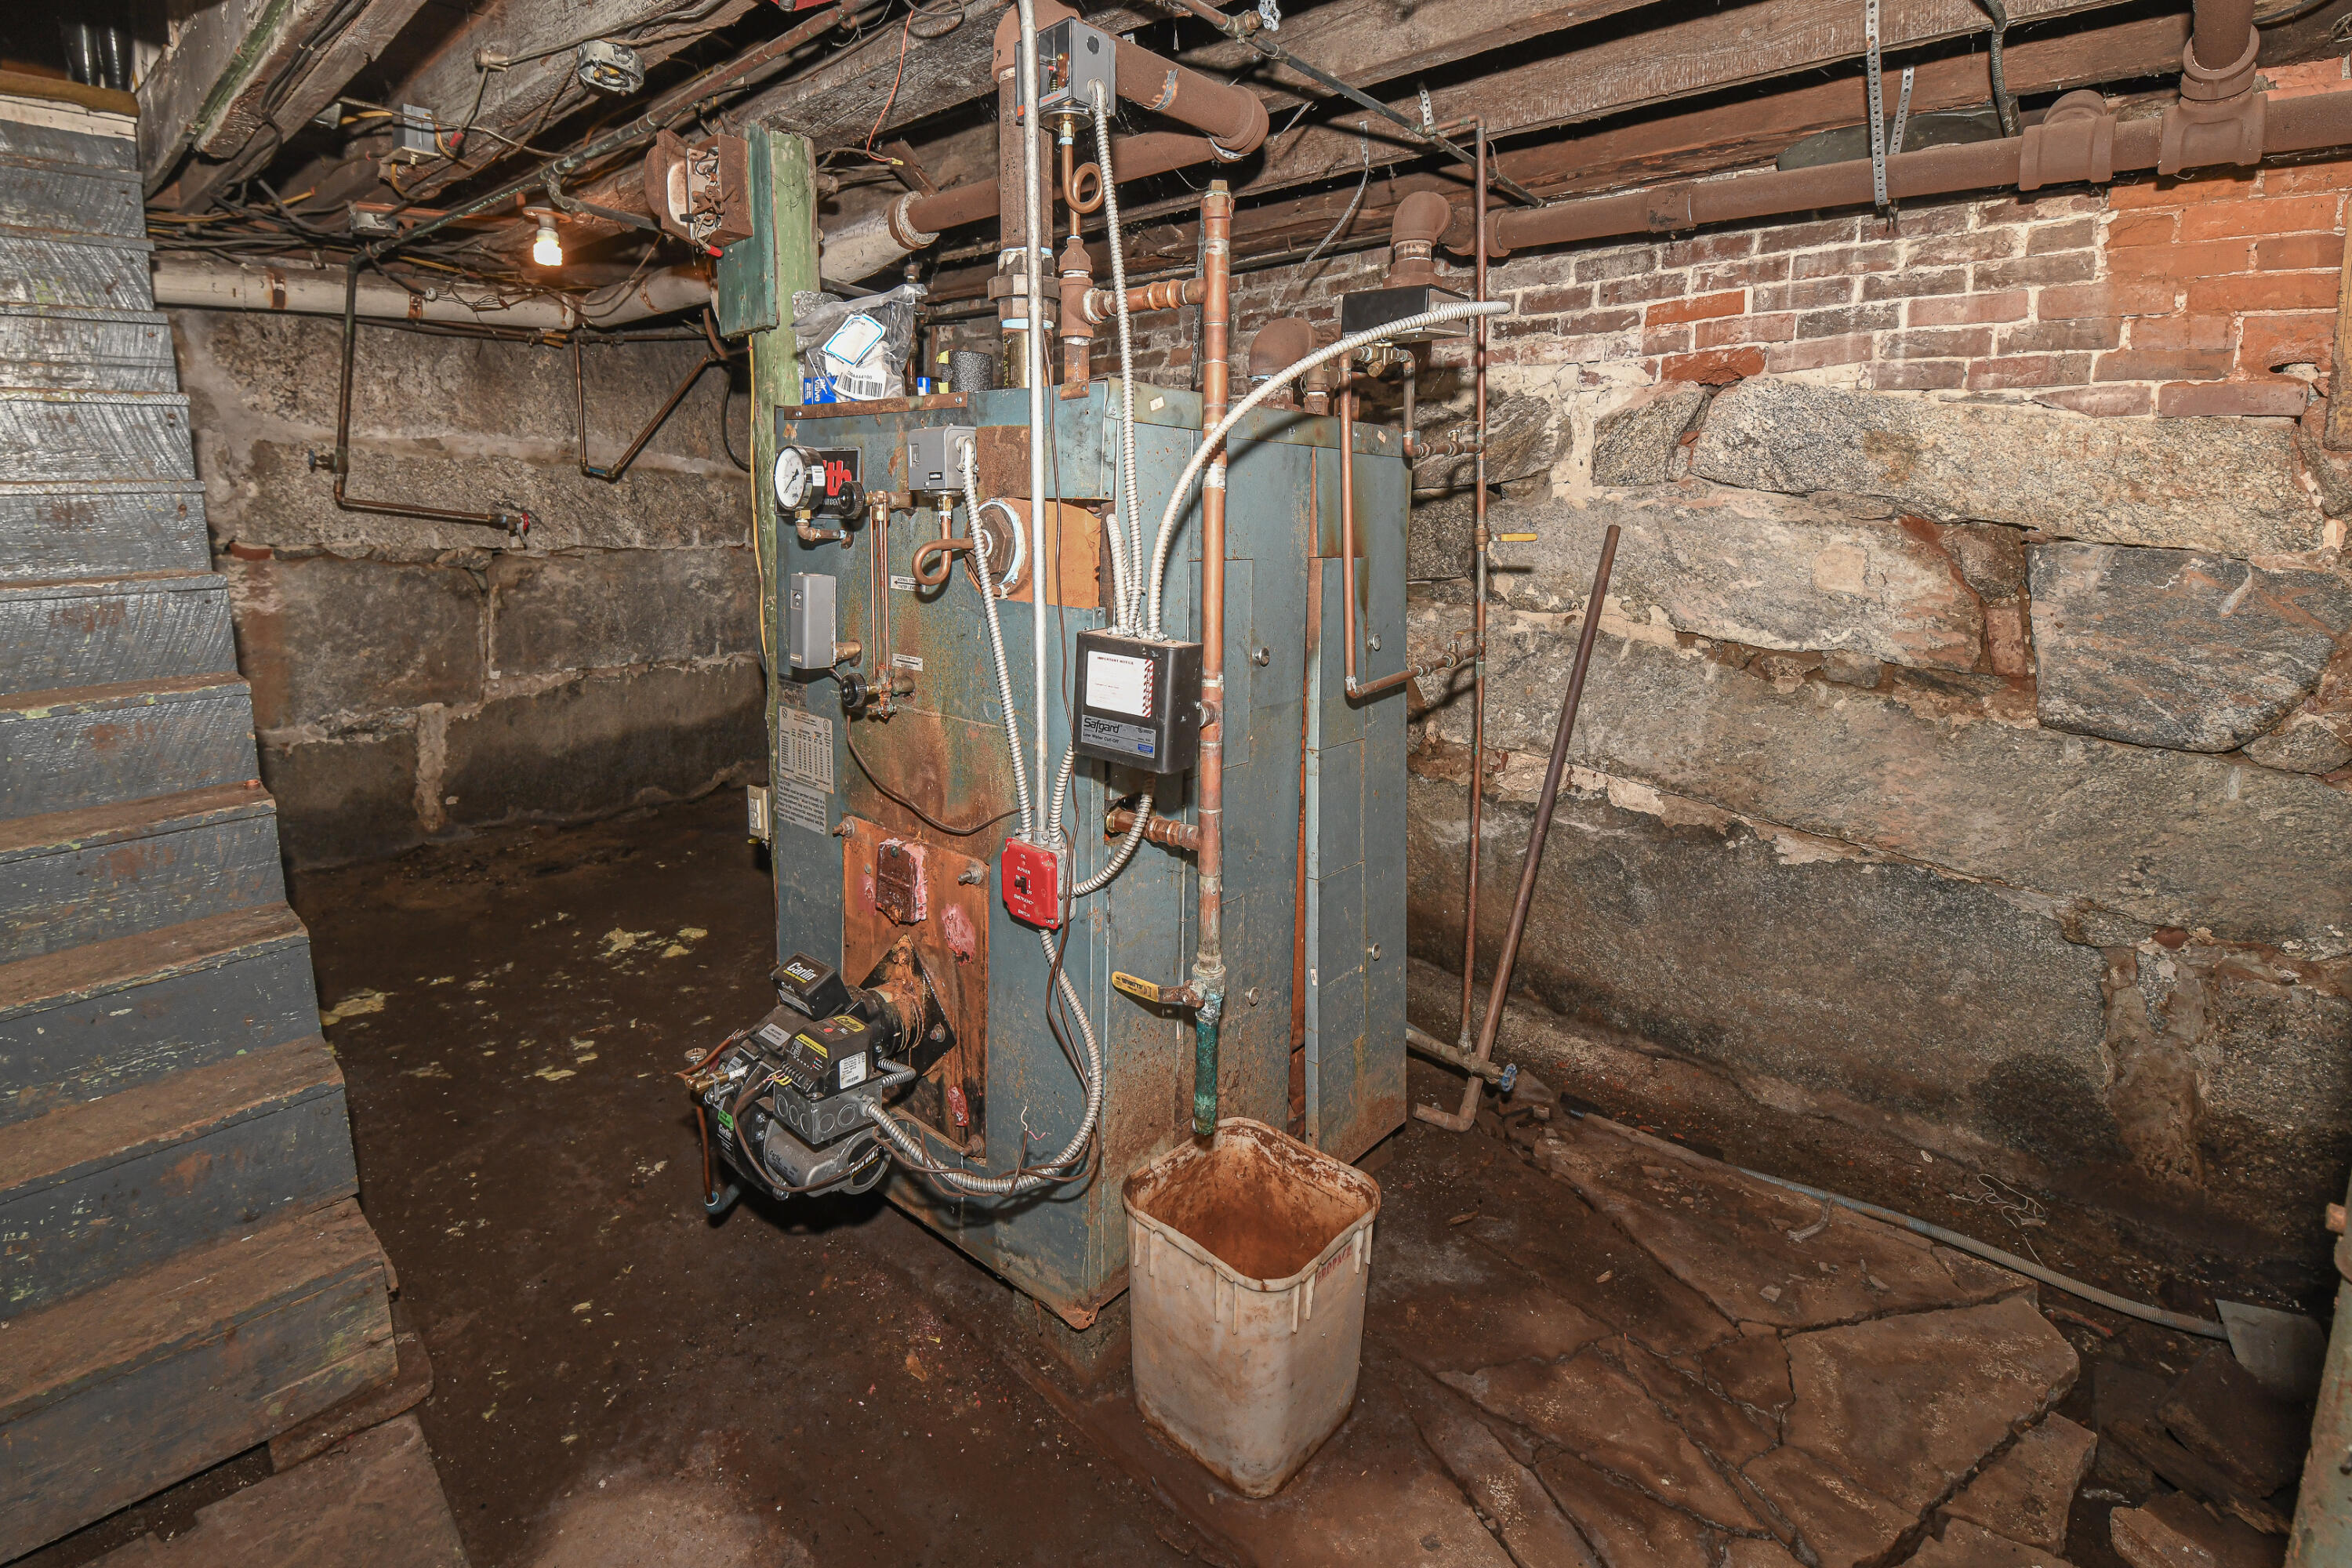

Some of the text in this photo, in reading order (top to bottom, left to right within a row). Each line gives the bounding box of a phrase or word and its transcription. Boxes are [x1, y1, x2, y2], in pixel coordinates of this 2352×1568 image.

[1083, 717, 1120, 734] Safgard
[1104, 735, 1120, 744] Cut-Off
[1014, 894, 1034, 906] EMERGENCY
[786, 962, 817, 981] Carlin
[718, 1123, 732, 1138] Carlin
